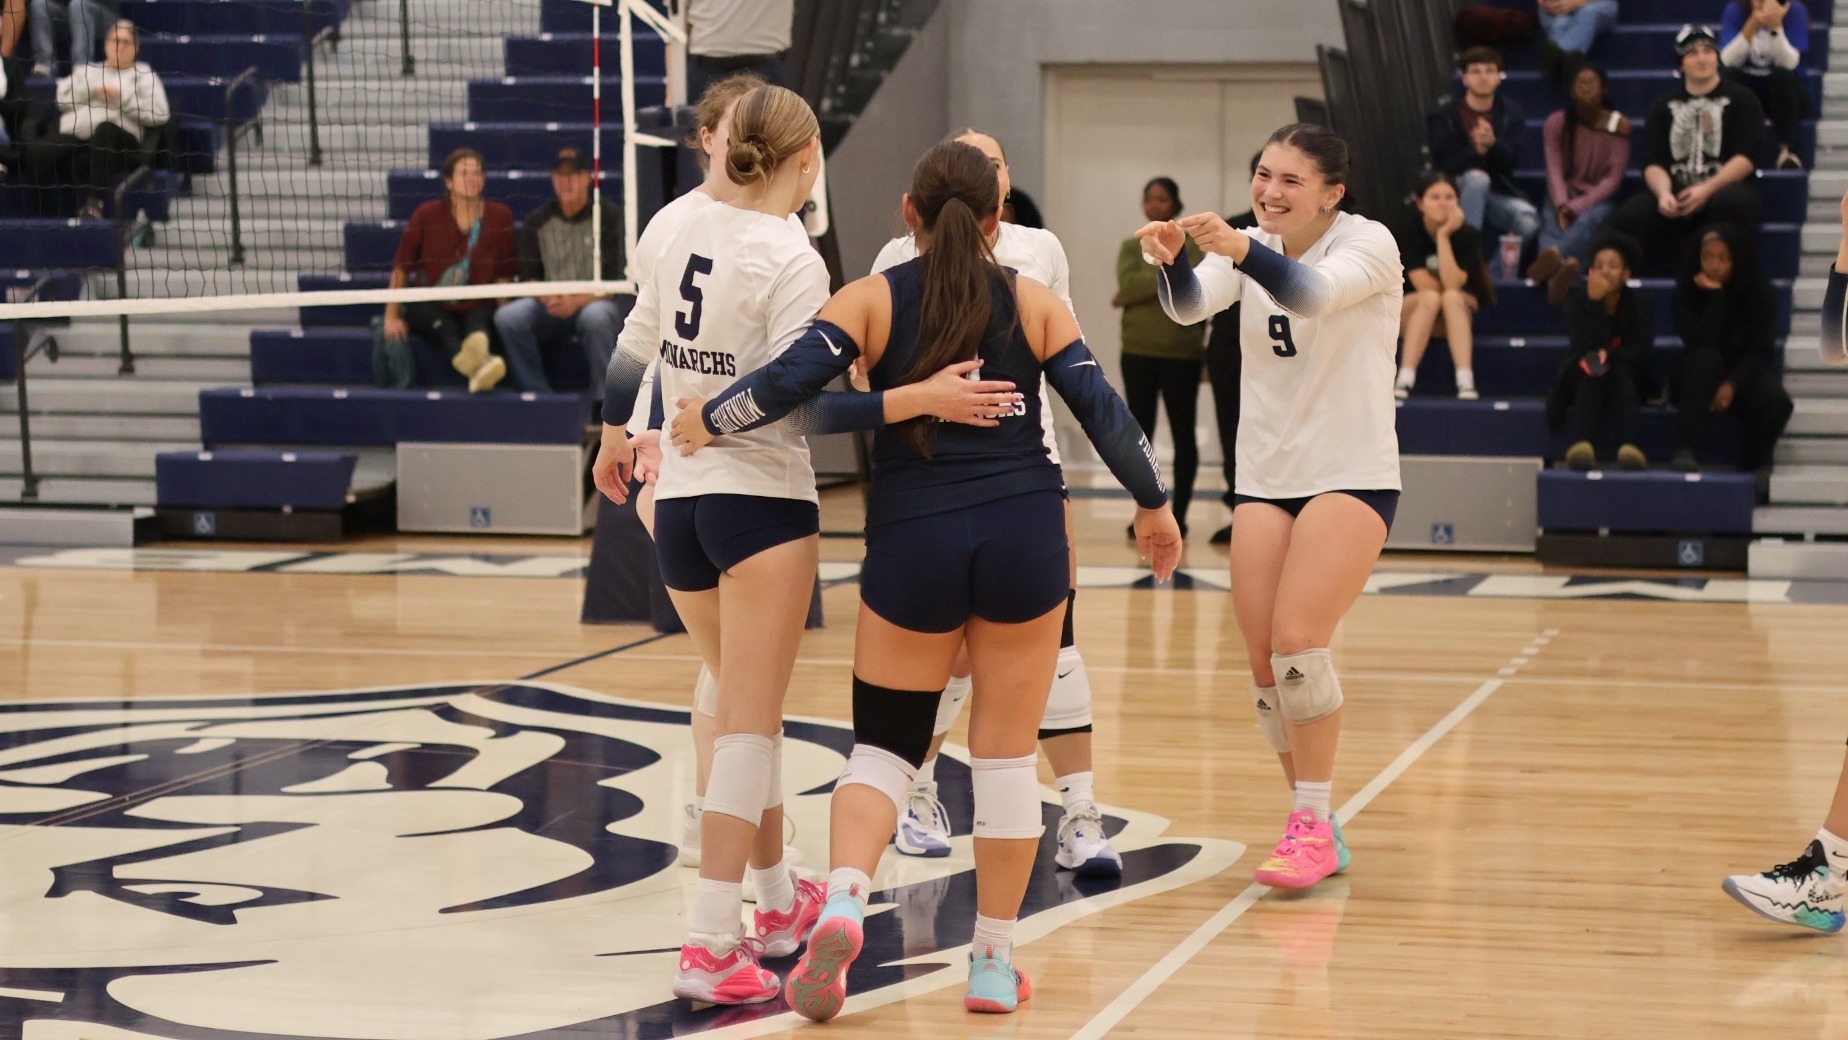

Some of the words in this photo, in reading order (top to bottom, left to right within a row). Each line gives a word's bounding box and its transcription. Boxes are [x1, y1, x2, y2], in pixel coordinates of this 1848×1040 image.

[675, 253, 713, 341] 5
[1268, 314, 1298, 358] 9
[659, 339, 736, 378] MONARCHS
